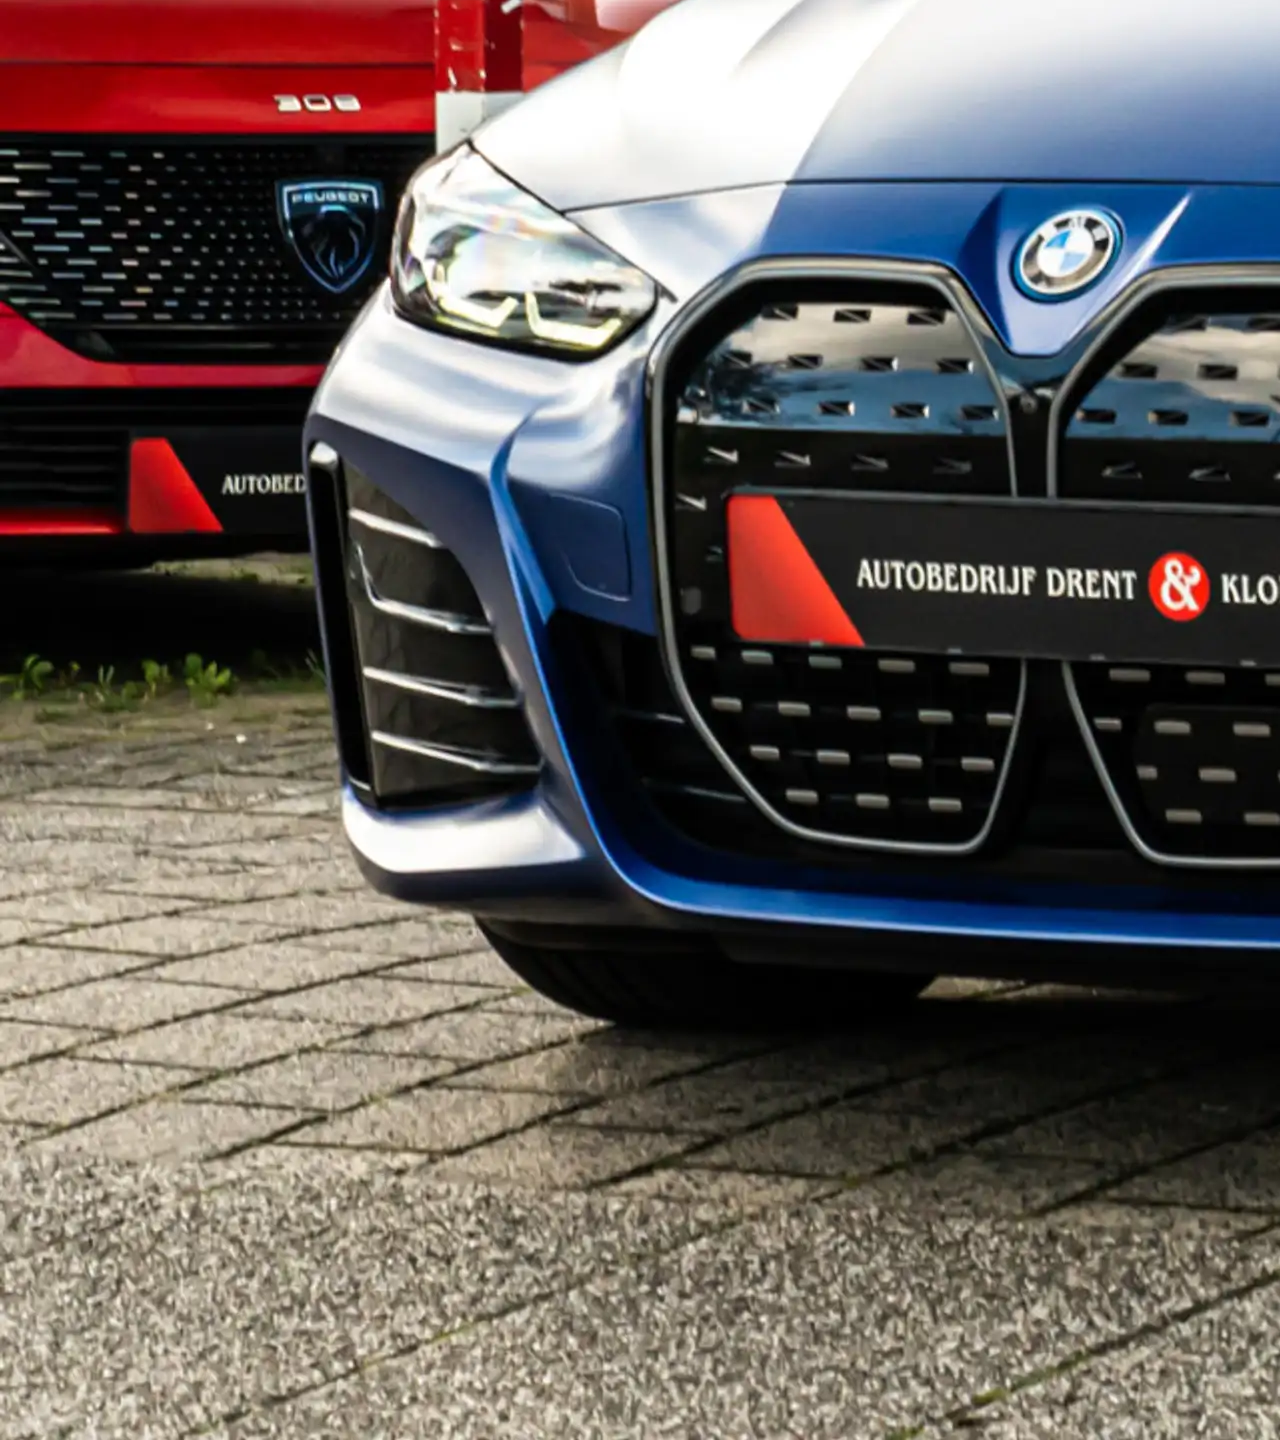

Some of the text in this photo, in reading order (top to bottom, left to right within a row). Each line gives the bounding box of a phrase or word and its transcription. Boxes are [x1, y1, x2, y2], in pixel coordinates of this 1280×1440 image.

[221, 472, 307, 495] AUTOBED
[856, 557, 1037, 597] AUTOBEDRIJF
[1045, 566, 1138, 601] DRENT
[1159, 557, 1202, 612] &
